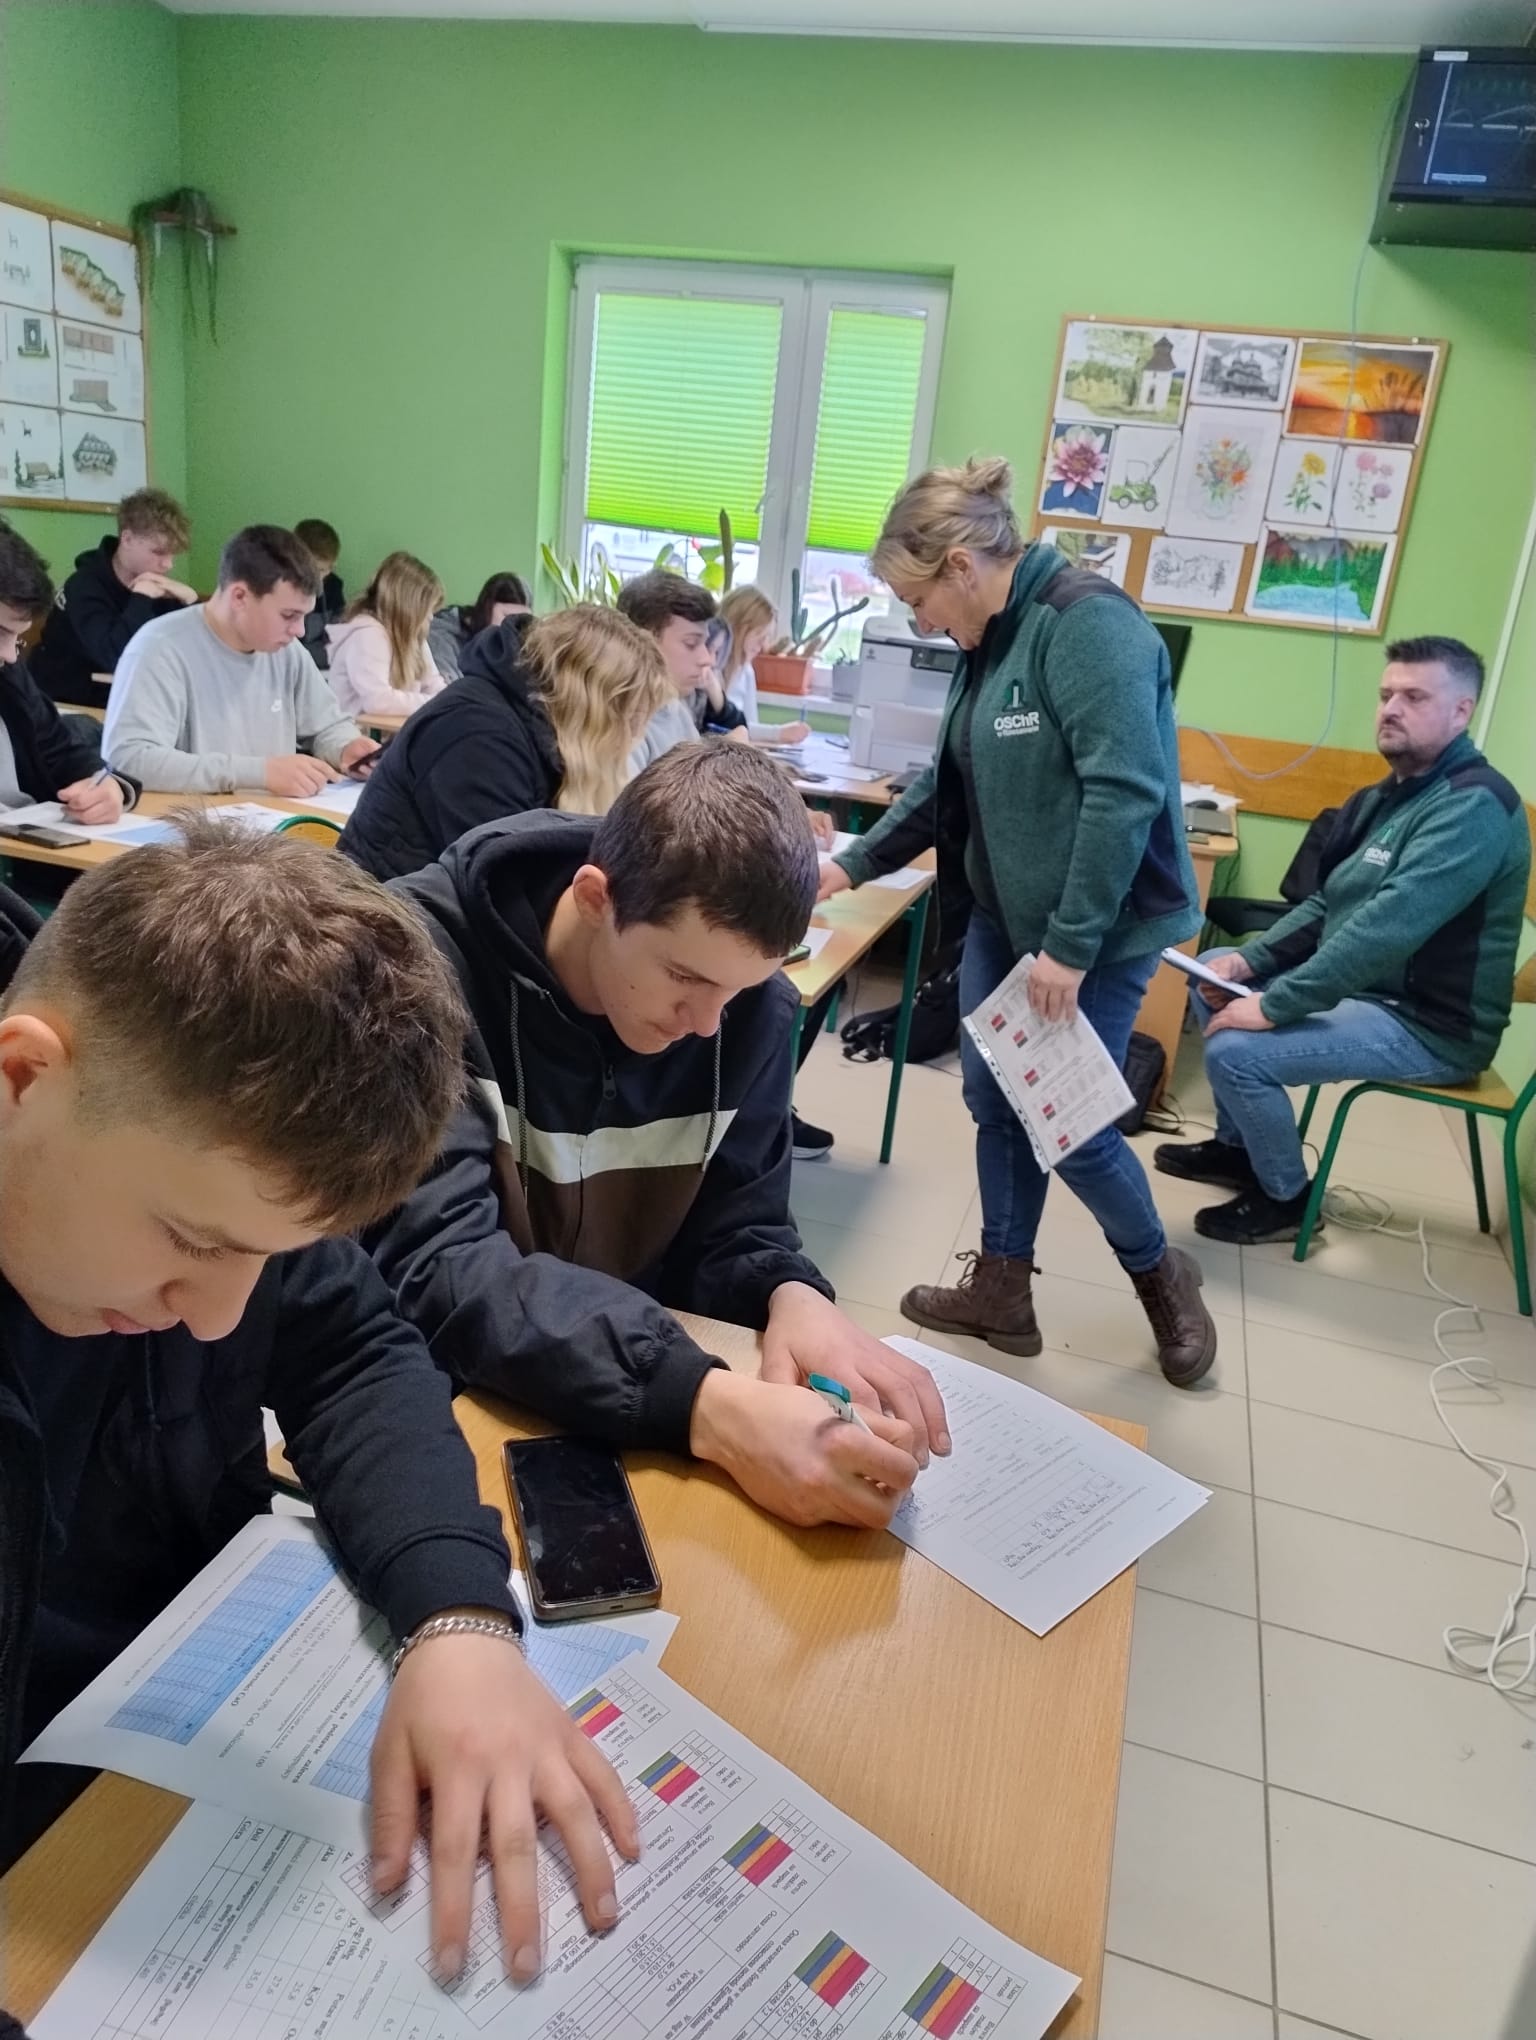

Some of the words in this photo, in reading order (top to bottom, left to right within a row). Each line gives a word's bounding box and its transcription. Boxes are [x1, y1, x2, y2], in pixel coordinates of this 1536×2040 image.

[993, 711, 1040, 731] OSChR
[780, 1927, 800, 1947] Ocena
[356, 1936, 375, 1961] osfor
[974, 1965, 983, 1975] IV
[847, 1979, 865, 1999] Kolor
